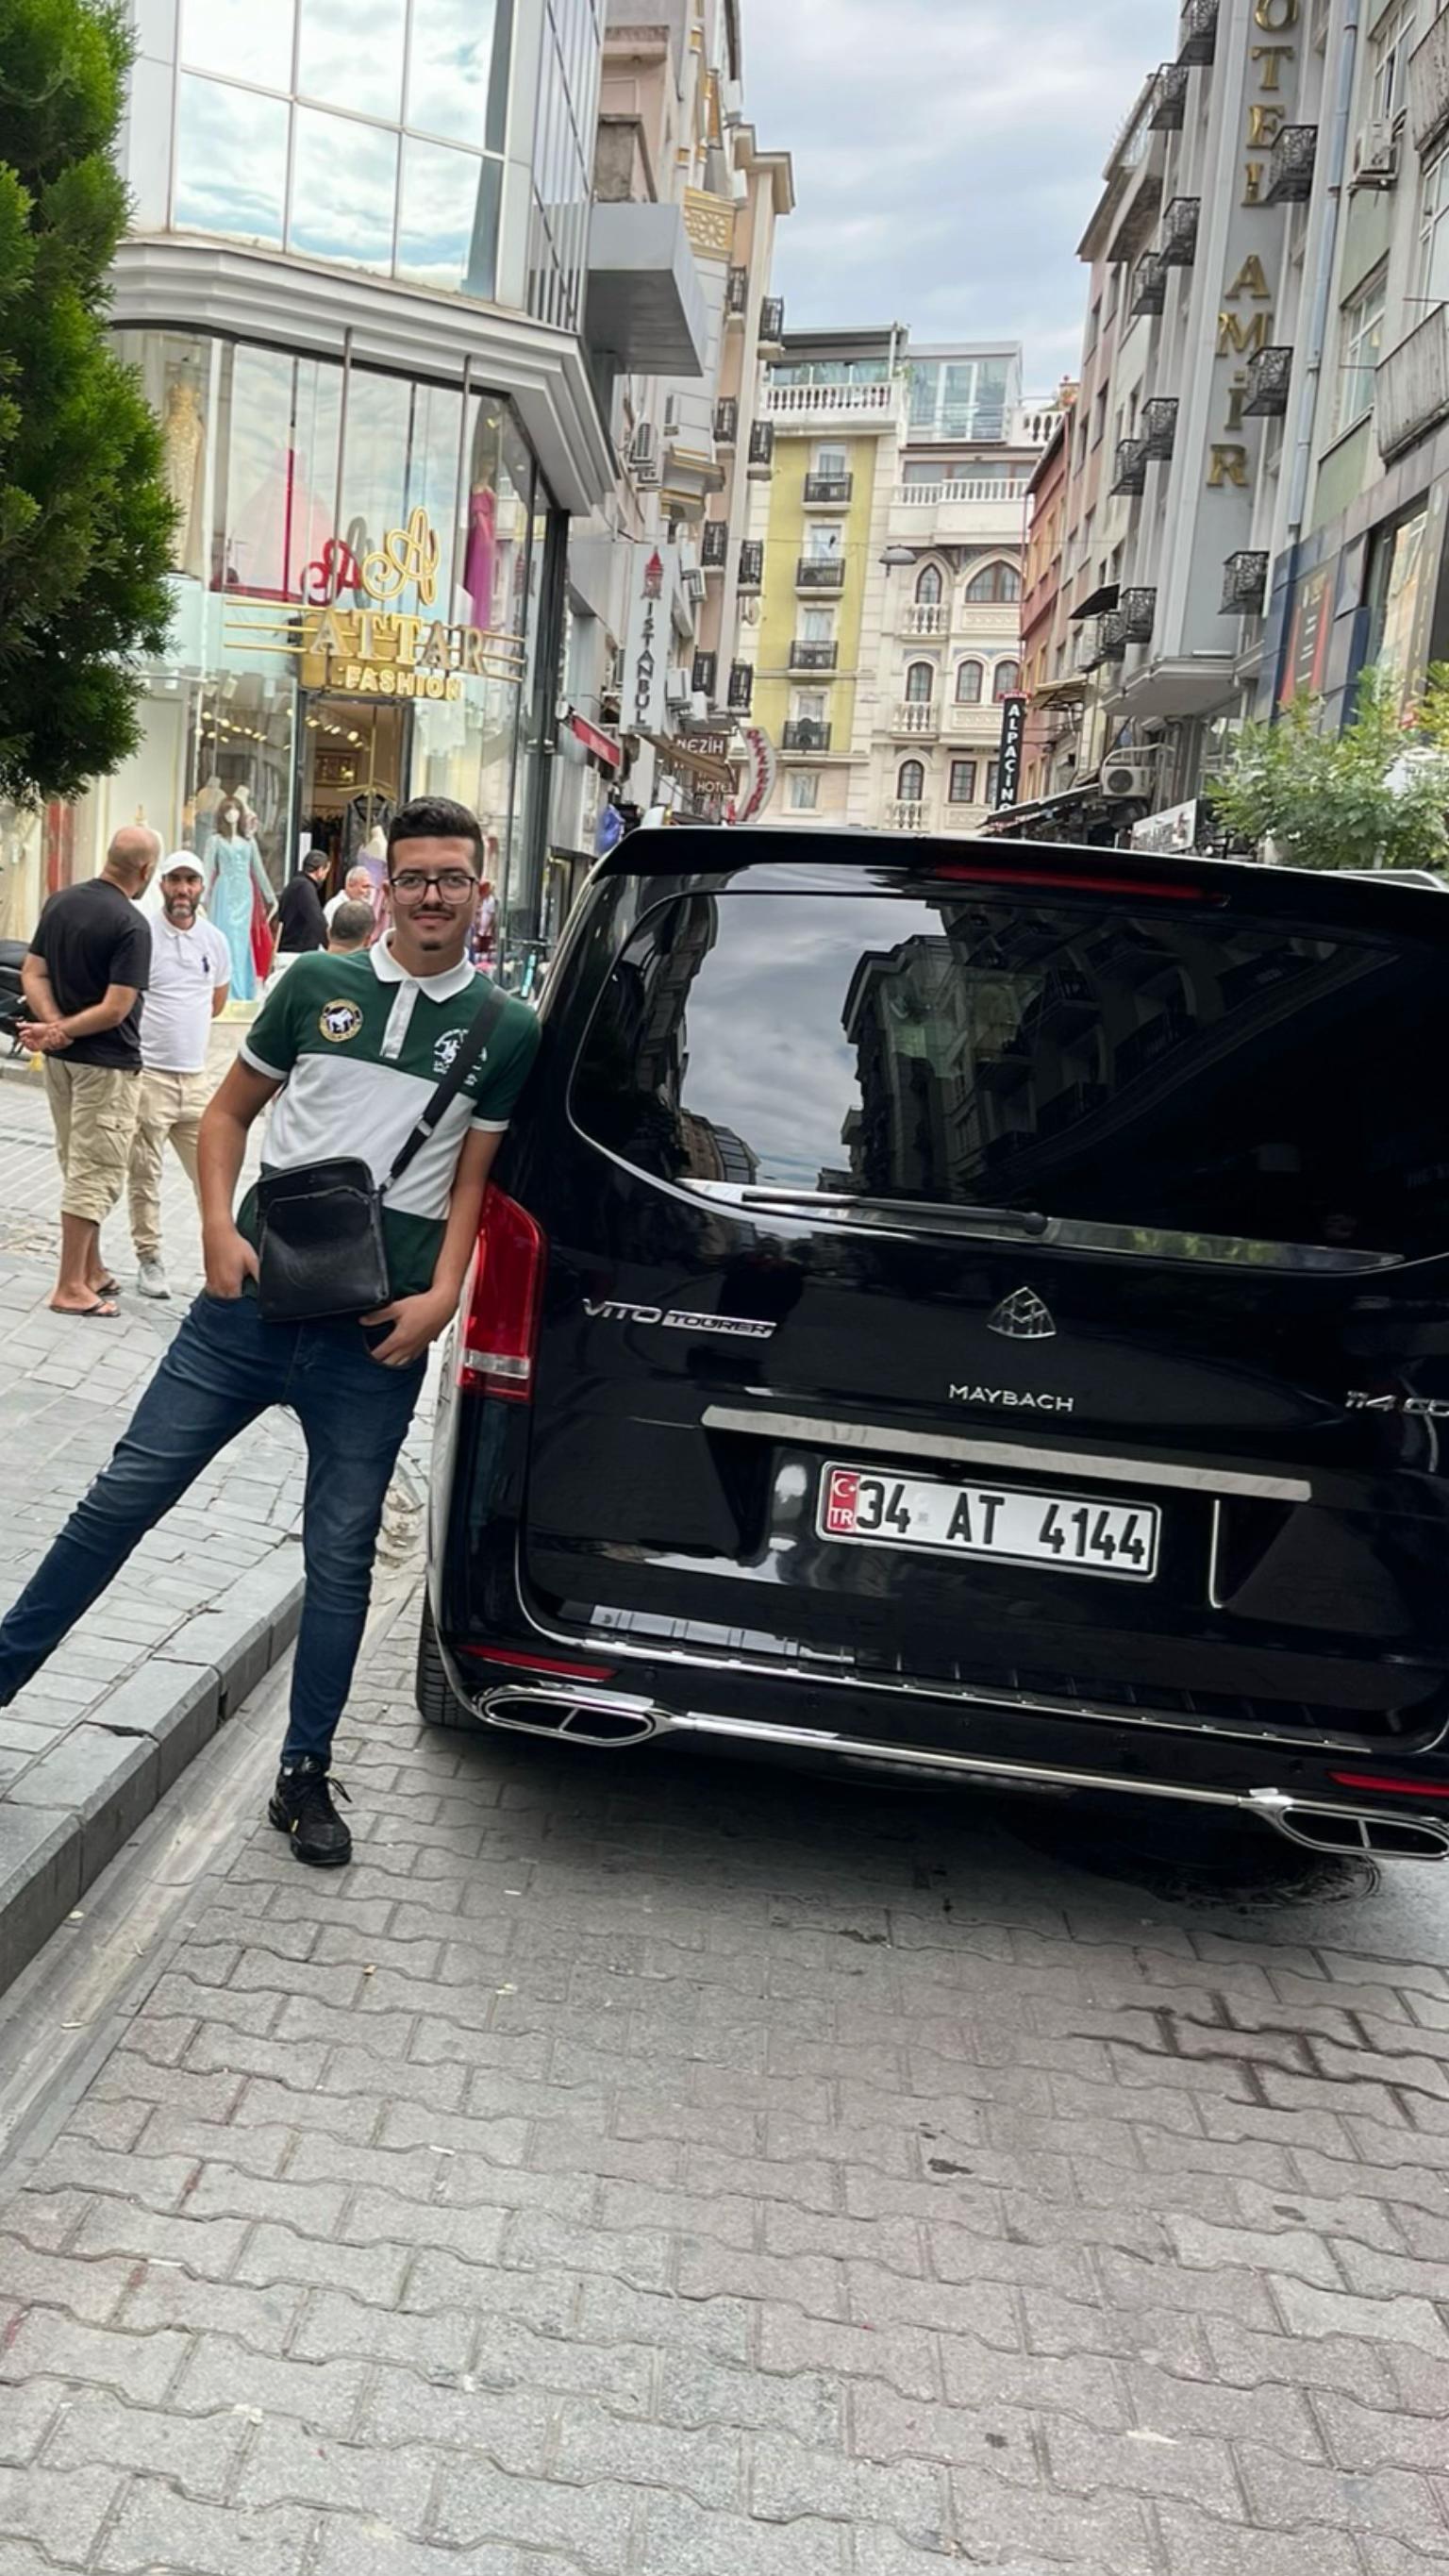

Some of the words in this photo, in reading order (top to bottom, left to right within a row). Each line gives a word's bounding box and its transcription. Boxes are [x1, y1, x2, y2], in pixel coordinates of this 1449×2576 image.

[308, 605, 489, 675] ATTAR
[343, 663, 462, 700] FASHION
[697, 780, 734, 793] HOTEL
[582, 1298, 662, 1324] VITO
[667, 1313, 773, 1335] TOURER
[949, 1383, 1074, 1413] MAYBACH
[829, 1508, 854, 1527] TR
[857, 1480, 911, 1533] 34
[946, 1492, 1006, 1545] AT
[1039, 1503, 1145, 1564] 4144
